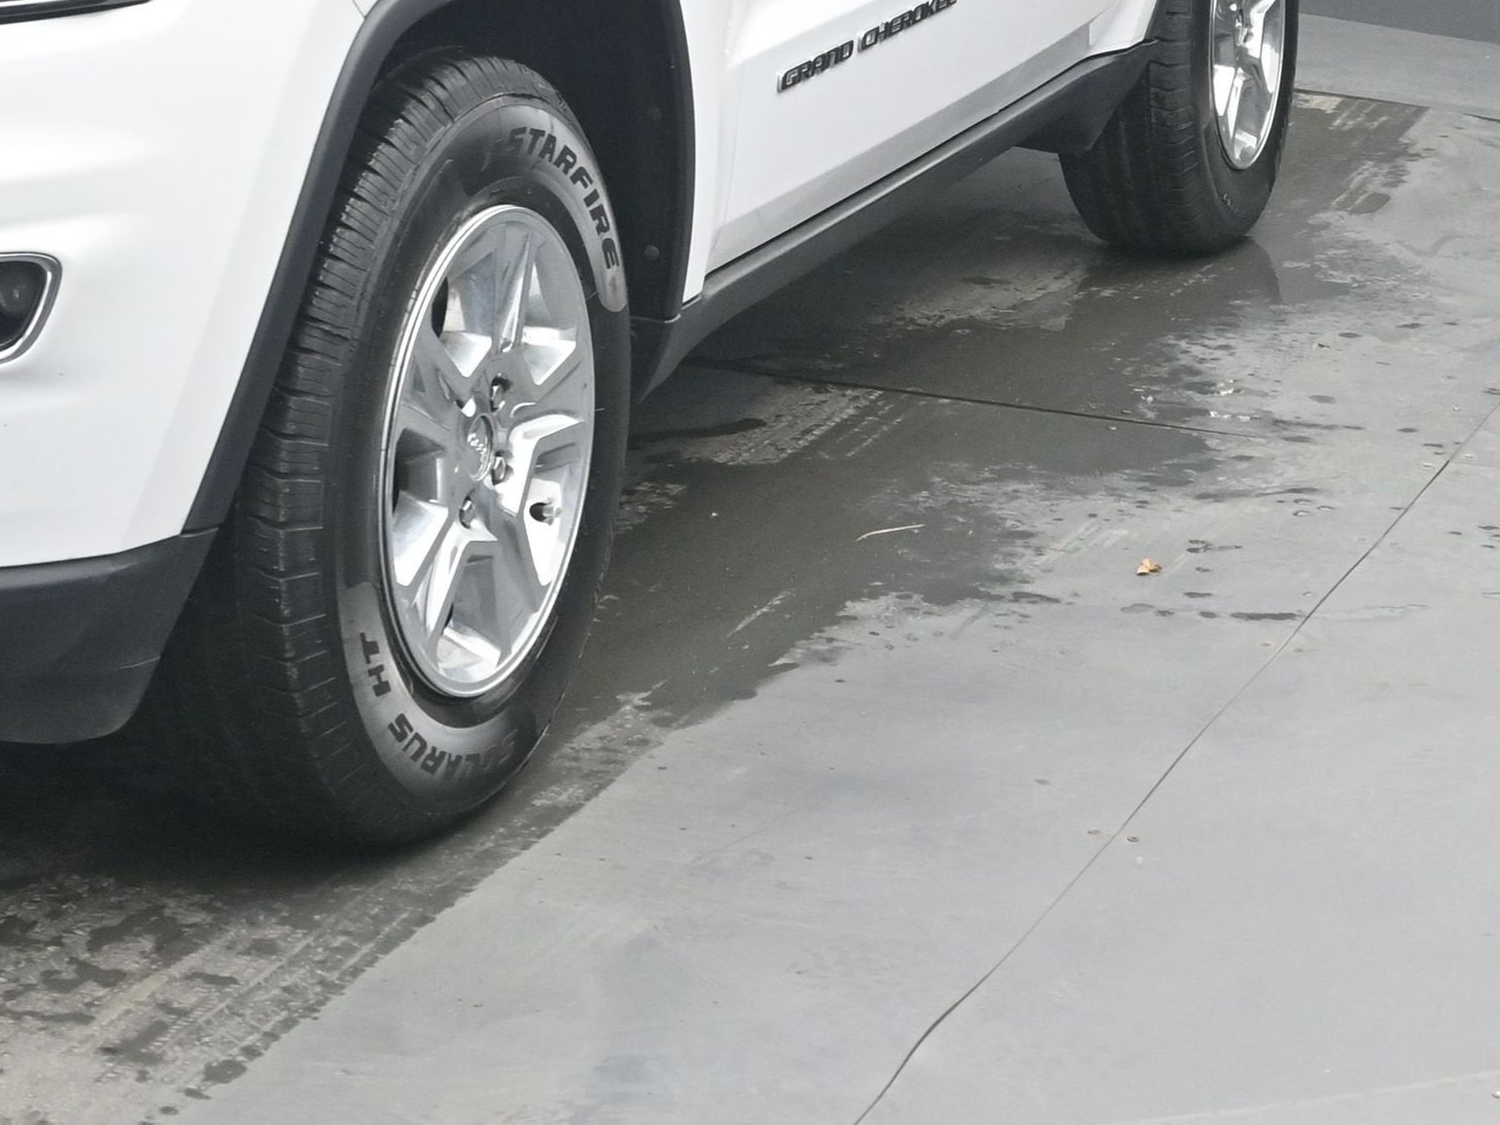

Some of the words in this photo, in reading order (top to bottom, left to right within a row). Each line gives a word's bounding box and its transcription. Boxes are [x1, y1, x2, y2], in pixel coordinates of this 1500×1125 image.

[777, 39, 854, 92] GRAND
[509, 126, 620, 270] STARFIRE
[359, 632, 392, 697] HT
